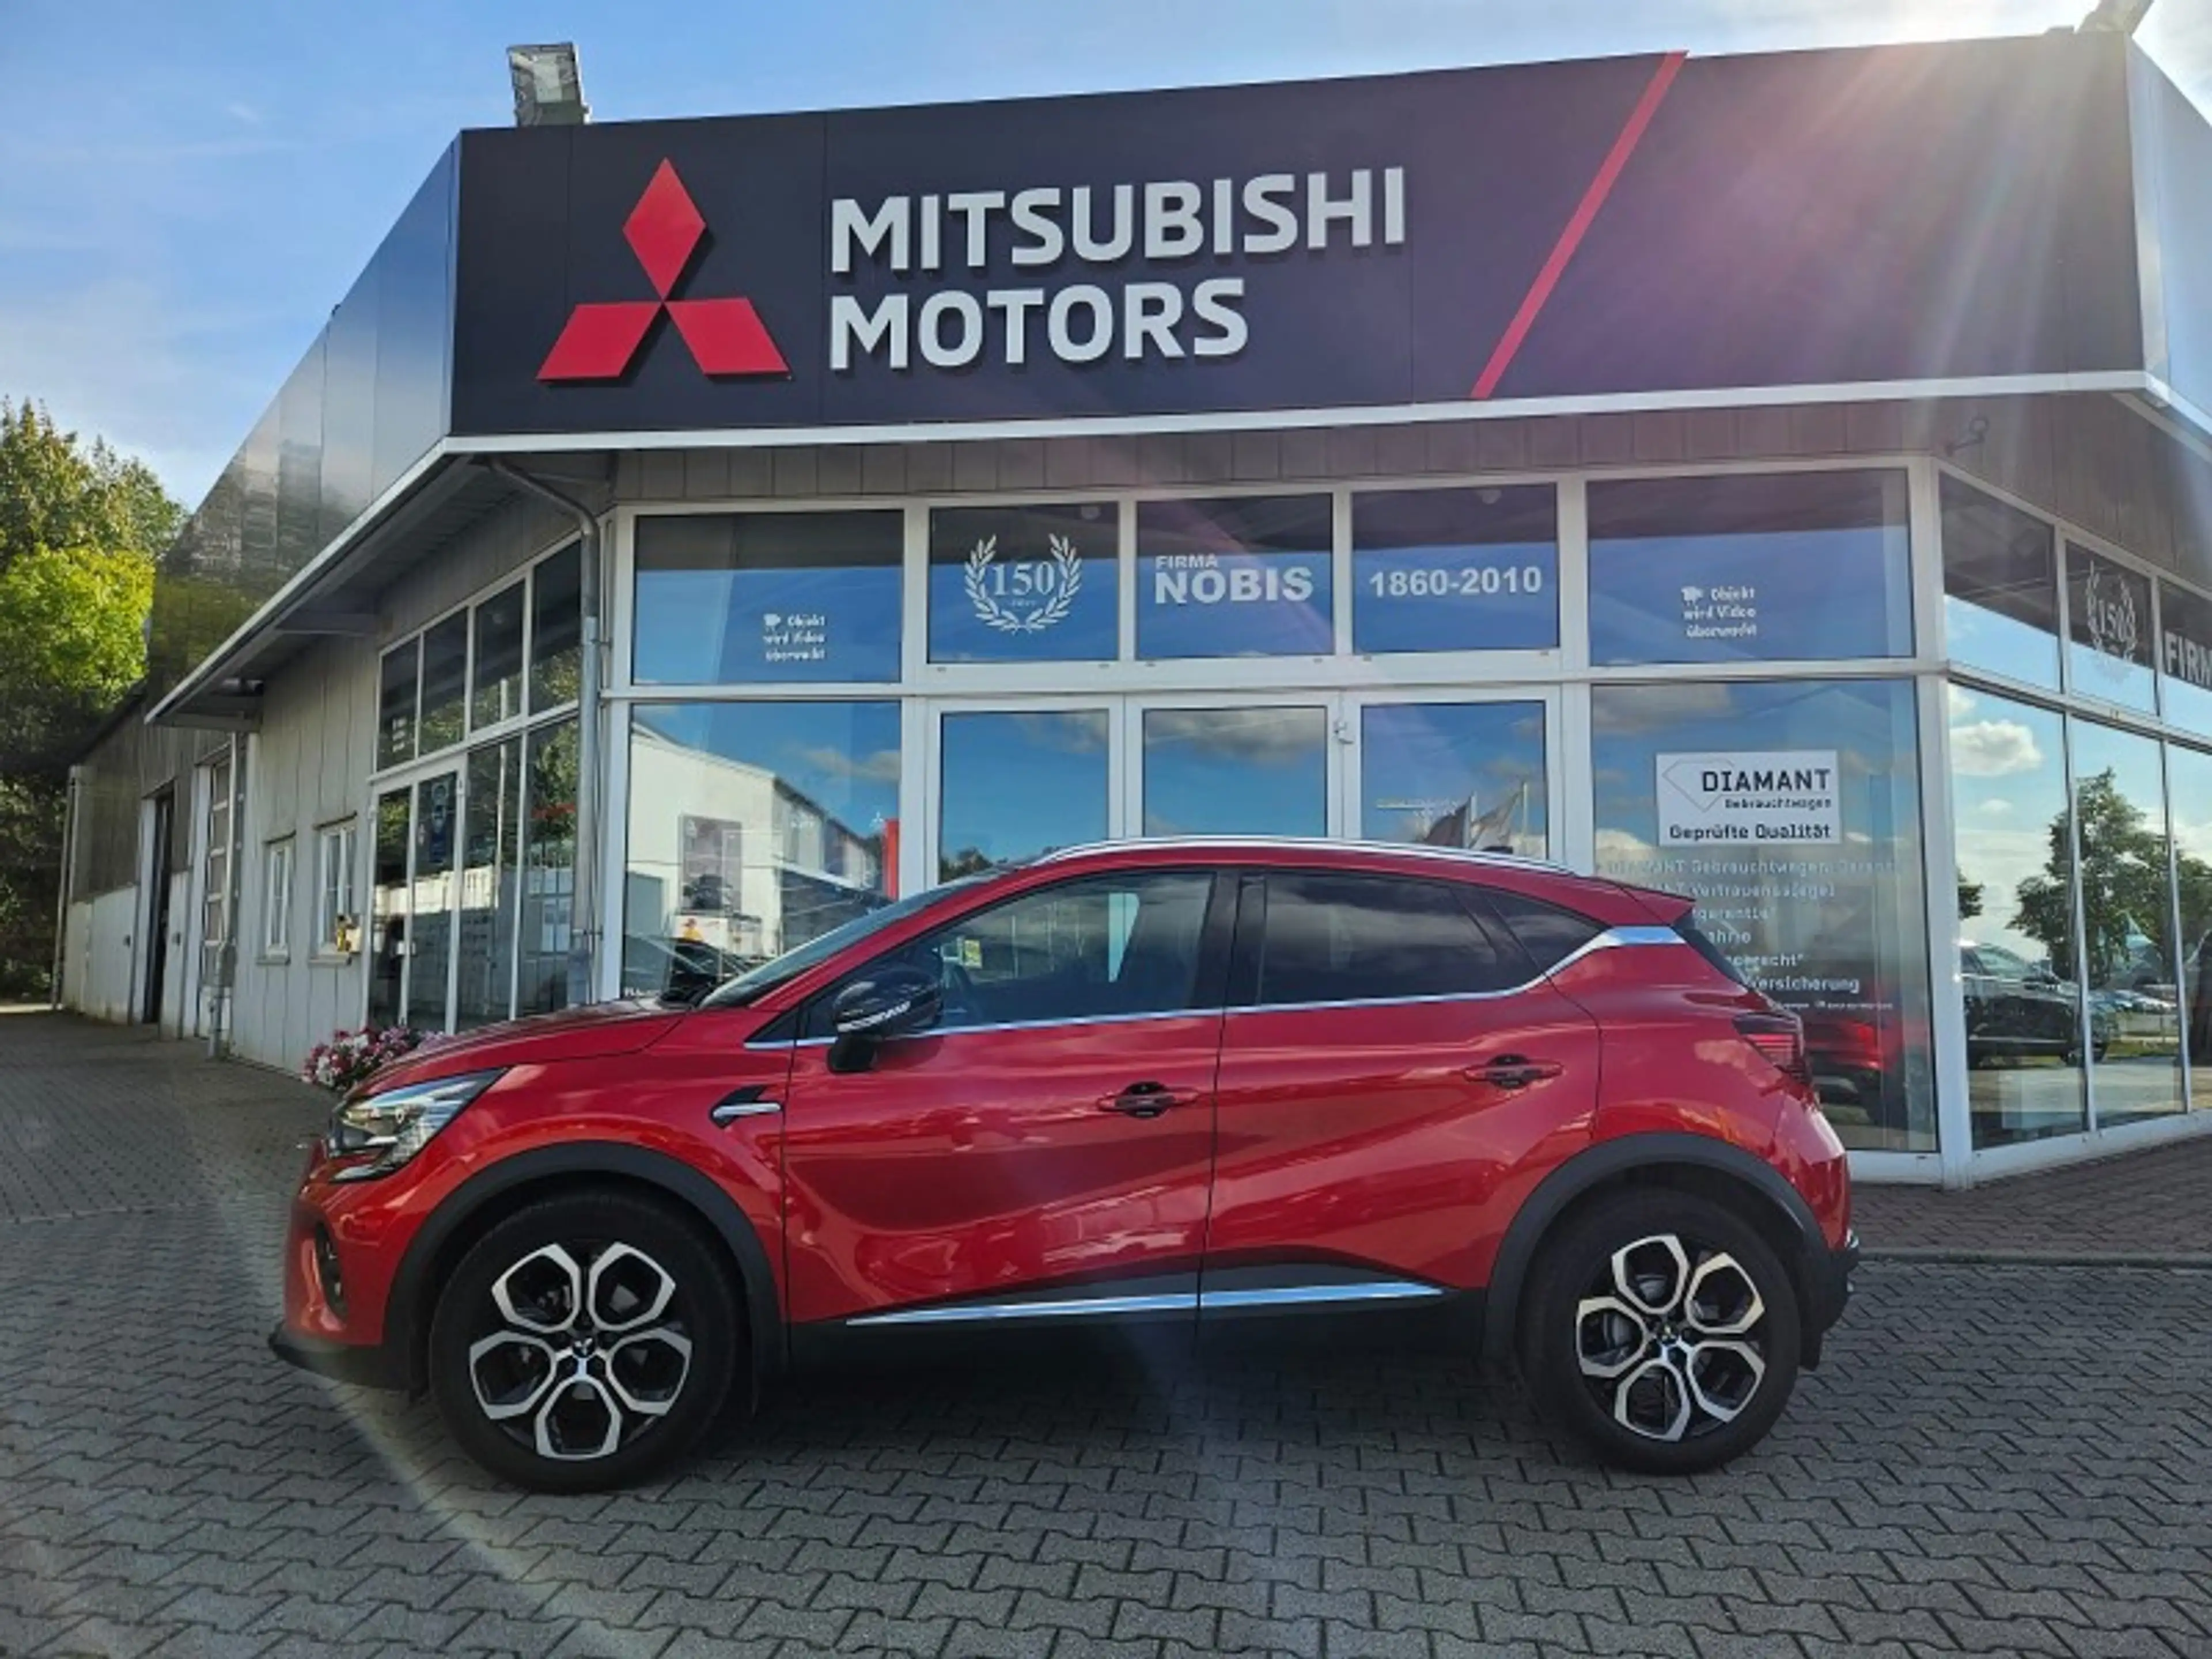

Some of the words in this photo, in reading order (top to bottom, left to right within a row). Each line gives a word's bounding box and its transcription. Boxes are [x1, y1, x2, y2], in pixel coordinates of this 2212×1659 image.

[831, 167, 1406, 274] MITSUBISHI
[830, 278, 1249, 370] MOTORS
[1156, 554, 1219, 569] FIRMA
[992, 561, 1055, 596] 150
[1155, 567, 1313, 604] NOBIS
[1369, 566, 1542, 598] 1860-2010
[1702, 768, 1831, 792] DIAMANT
[1725, 798, 1831, 812] Gebrauchtwagen
[1669, 822, 1749, 842] Geprüfte
[1755, 823, 1831, 839] Qualität
